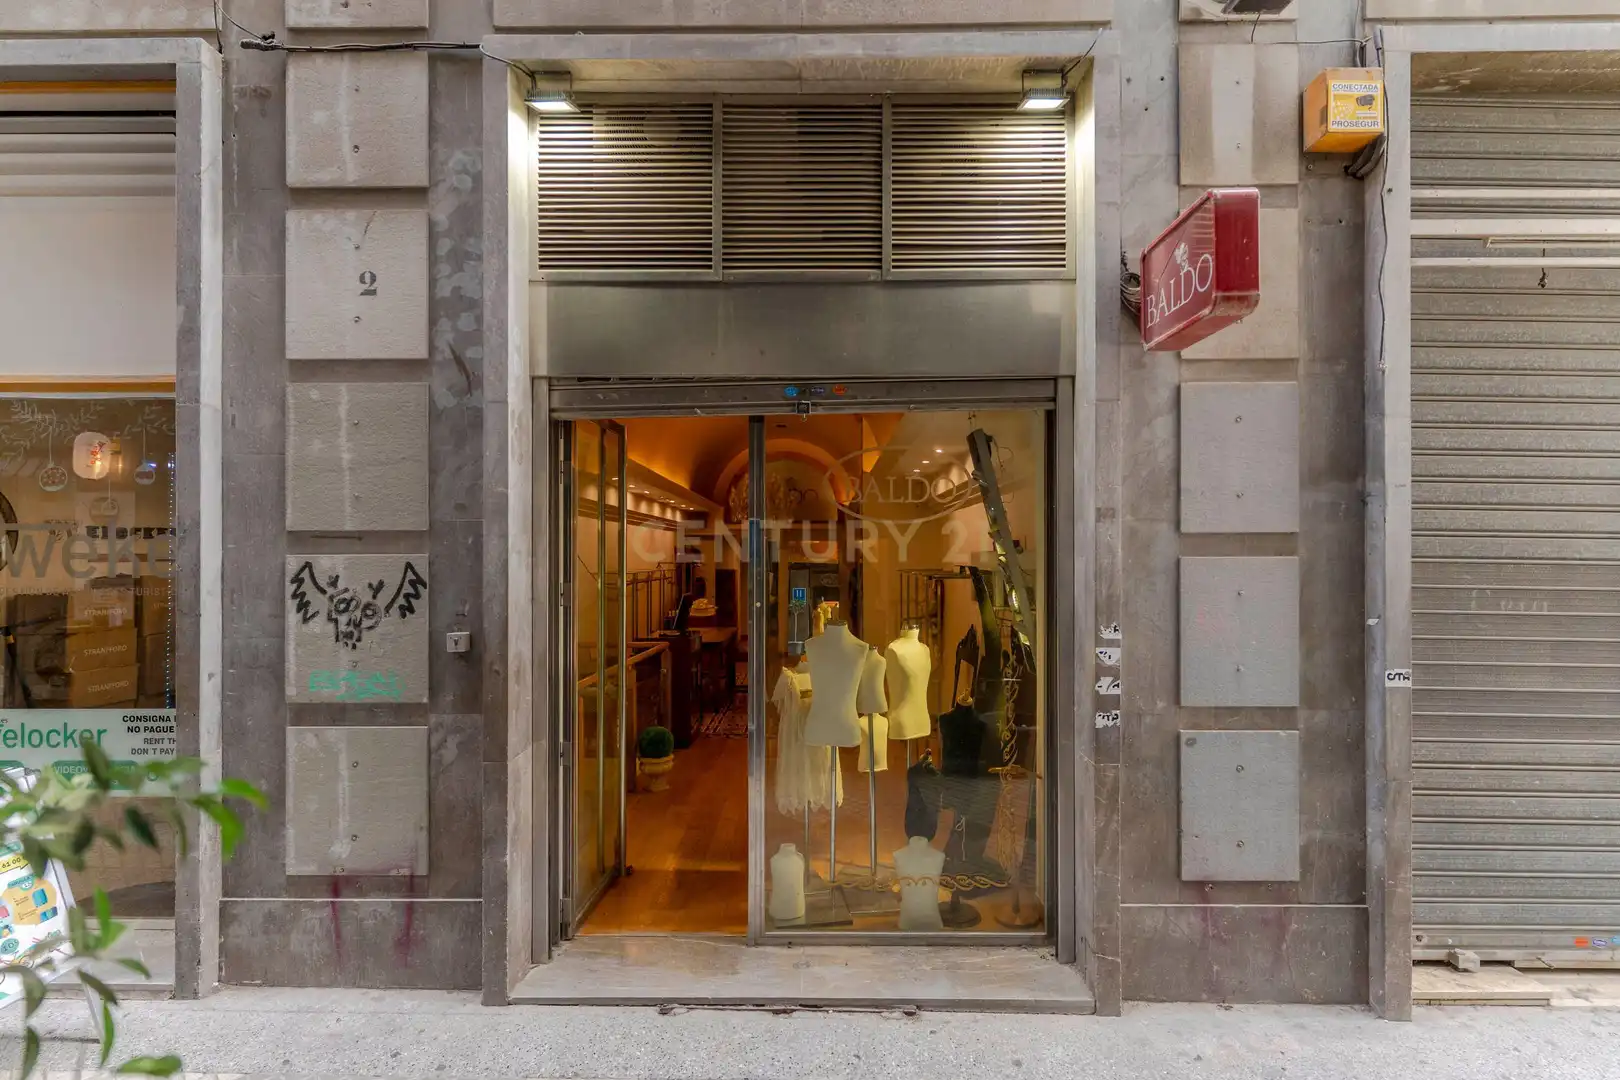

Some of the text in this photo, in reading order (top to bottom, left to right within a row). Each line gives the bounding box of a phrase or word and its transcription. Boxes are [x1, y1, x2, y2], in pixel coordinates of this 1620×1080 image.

[1332, 83, 1379, 91] CONECTADA
[1332, 120, 1380, 128] PROSEGUR
[359, 270, 377, 297] 2
[1146, 253, 1213, 328] BALDO
[845, 475, 957, 504] BALDO
[122, 715, 171, 723] CONSIGNA
[160, 747, 175, 755] PAY
